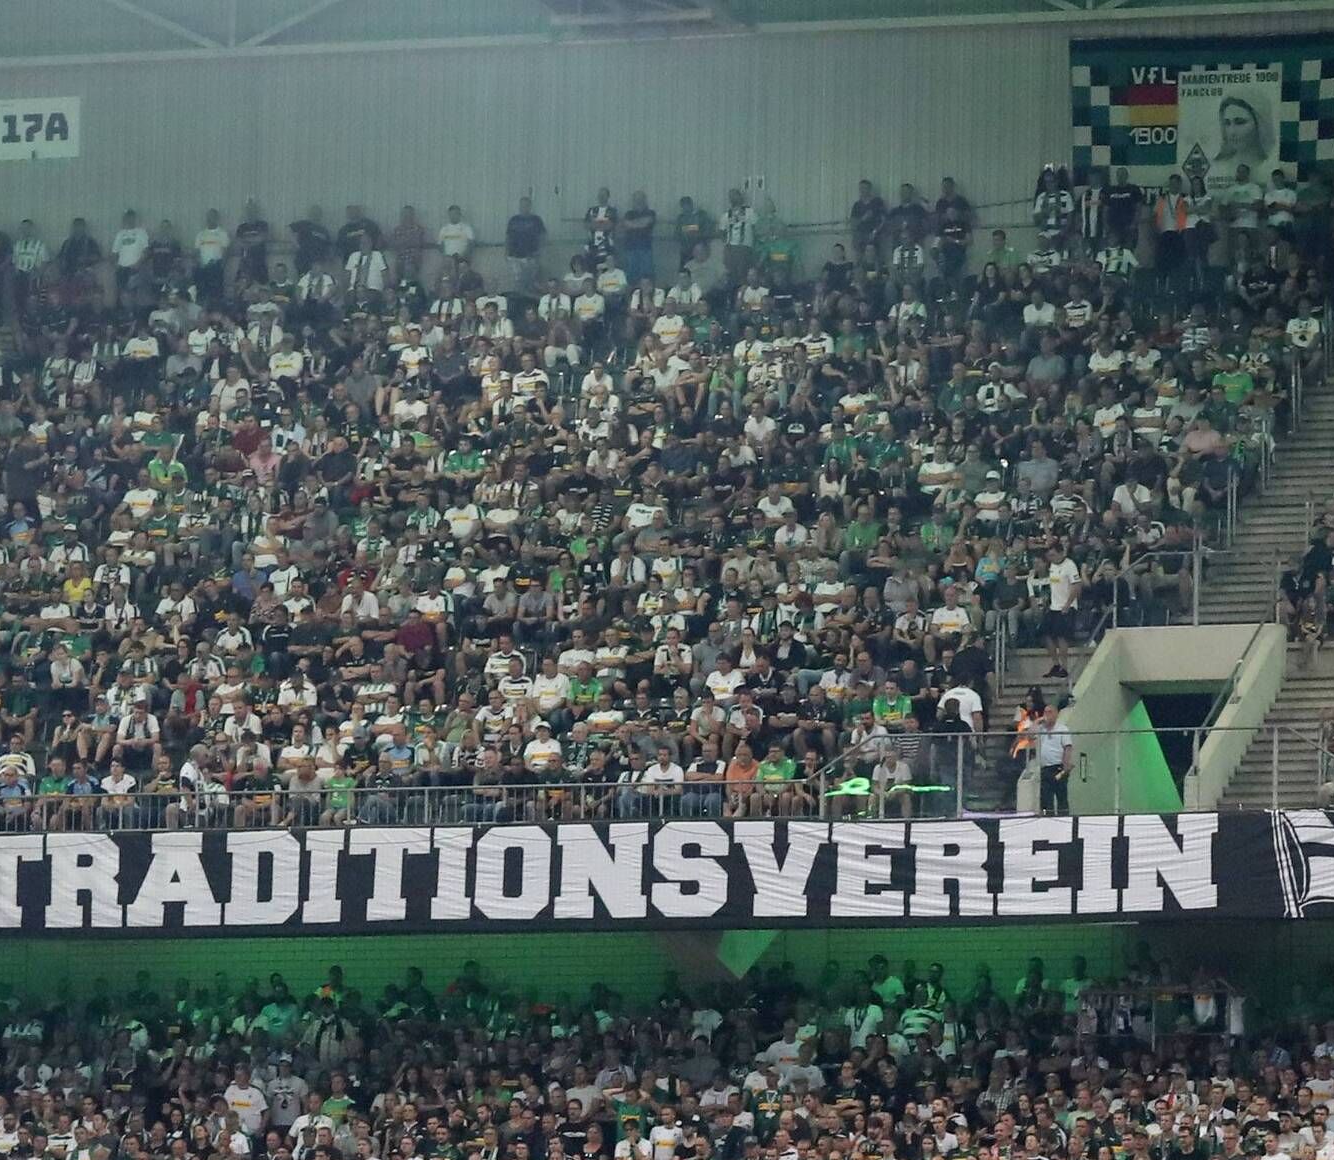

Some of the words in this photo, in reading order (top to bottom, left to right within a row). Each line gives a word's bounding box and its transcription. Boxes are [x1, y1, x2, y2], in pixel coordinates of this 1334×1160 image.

[1131, 66, 1176, 84] VfL
[2, 112, 69, 143] 17A
[1128, 127, 1177, 145] 1900
